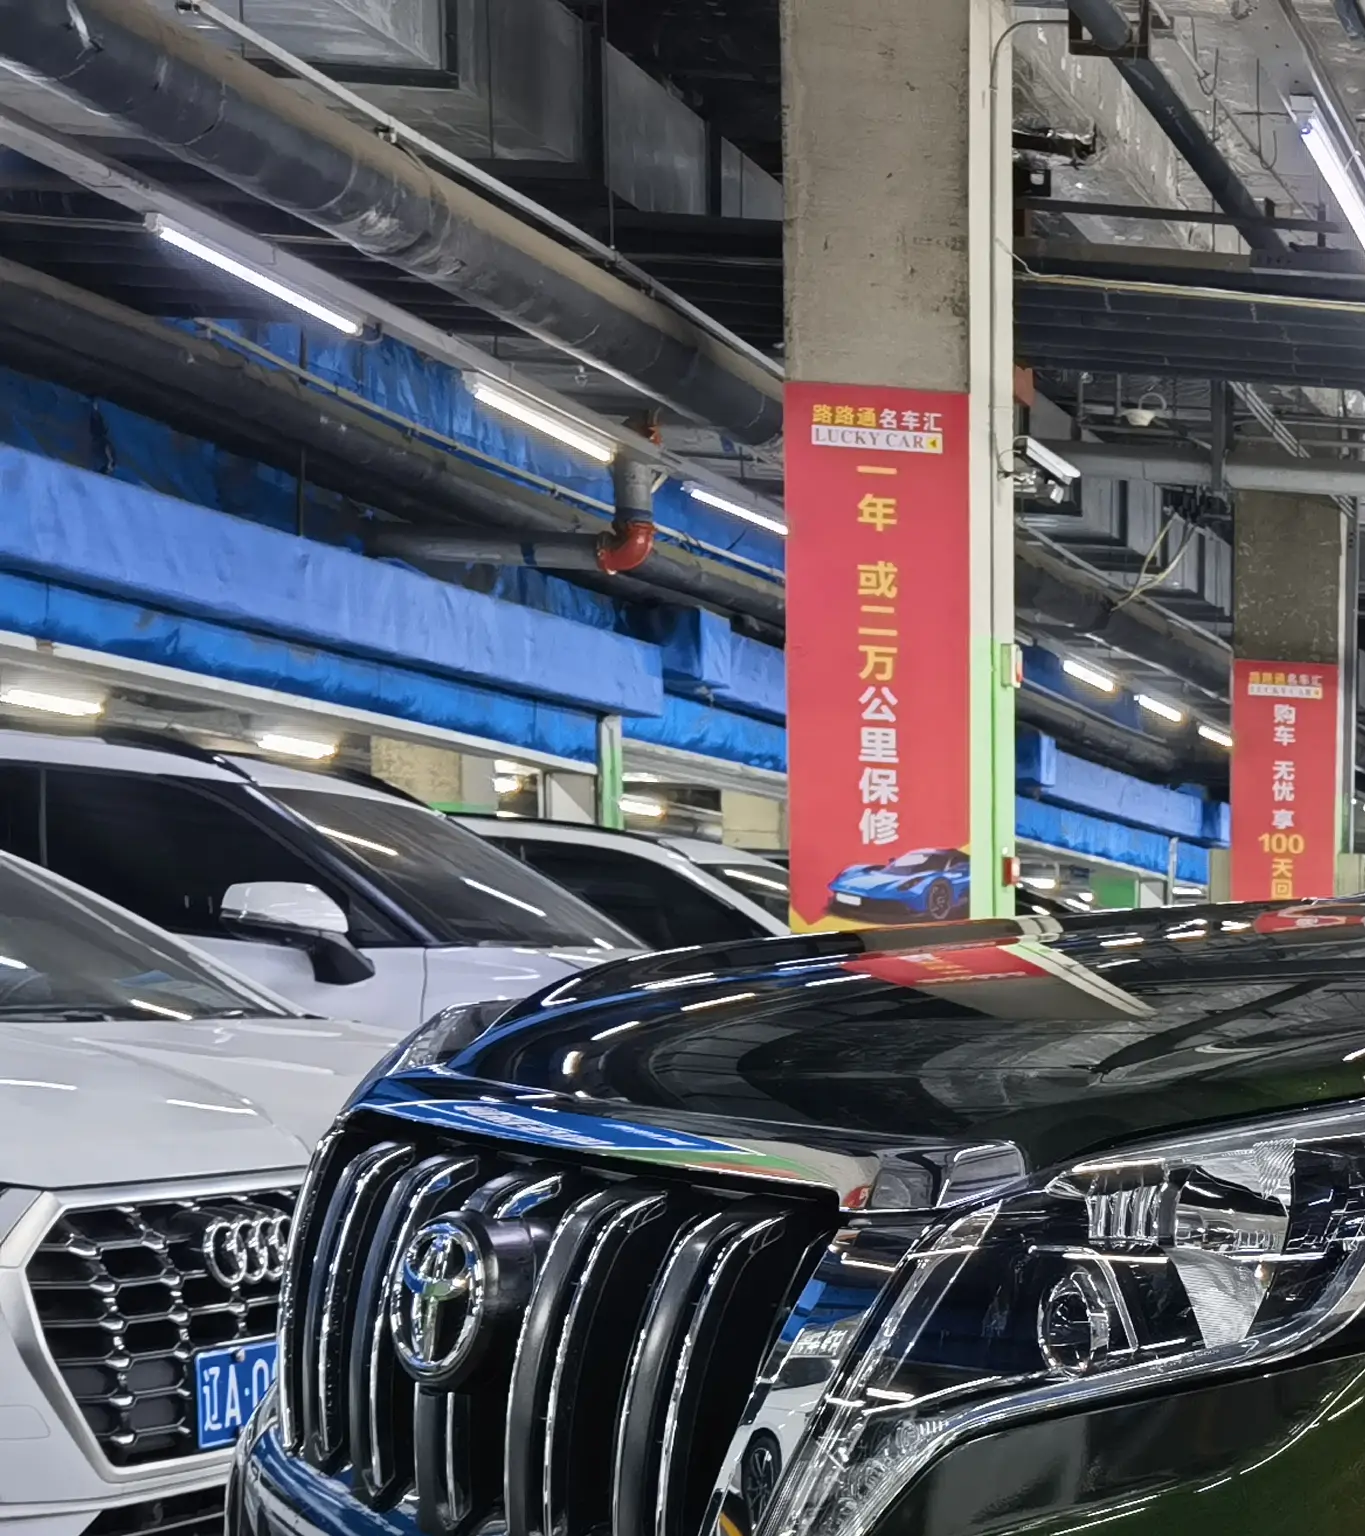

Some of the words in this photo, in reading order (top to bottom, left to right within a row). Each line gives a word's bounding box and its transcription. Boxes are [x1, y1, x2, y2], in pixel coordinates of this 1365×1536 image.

[812, 404, 943, 432] 路路通名车汇
[815, 427, 880, 446] LUCKY
[885, 433, 925, 450] CAR
